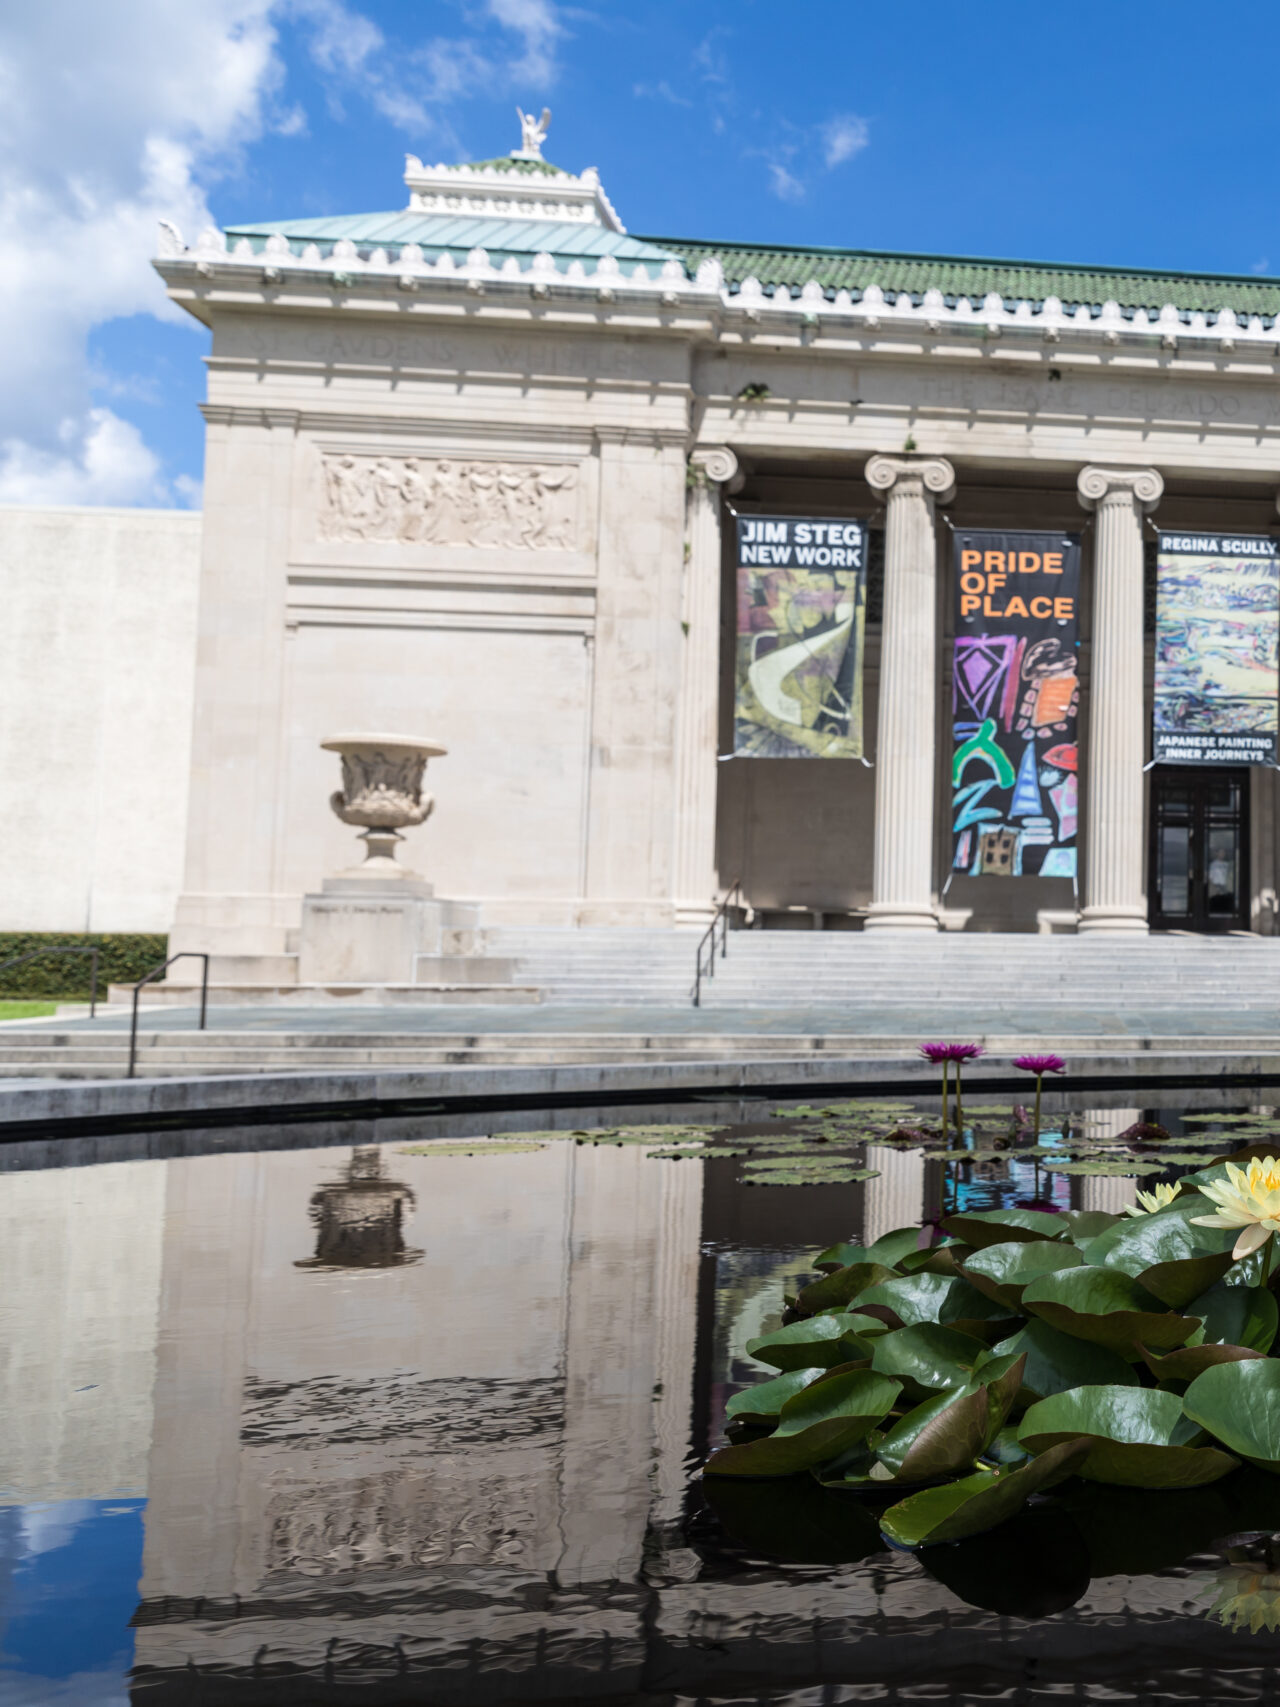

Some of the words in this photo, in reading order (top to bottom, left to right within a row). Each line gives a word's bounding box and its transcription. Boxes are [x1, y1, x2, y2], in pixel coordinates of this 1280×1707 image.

[741, 522, 788, 543] JIM
[794, 524, 862, 546] STEG
[740, 545, 792, 565] NEW
[795, 546, 862, 568] WORK
[1162, 537, 1219, 552] REGINA
[1221, 540, 1278, 555] SCULLY
[961, 549, 1064, 575] PRIDE
[960, 572, 1007, 595] OF
[960, 595, 1075, 620] PLACE
[1158, 735, 1217, 748] JAPANESE
[1218, 738, 1273, 750] PAINTING
[1165, 748, 1202, 760] INNER
[1204, 750, 1265, 762] JOURNEYS
